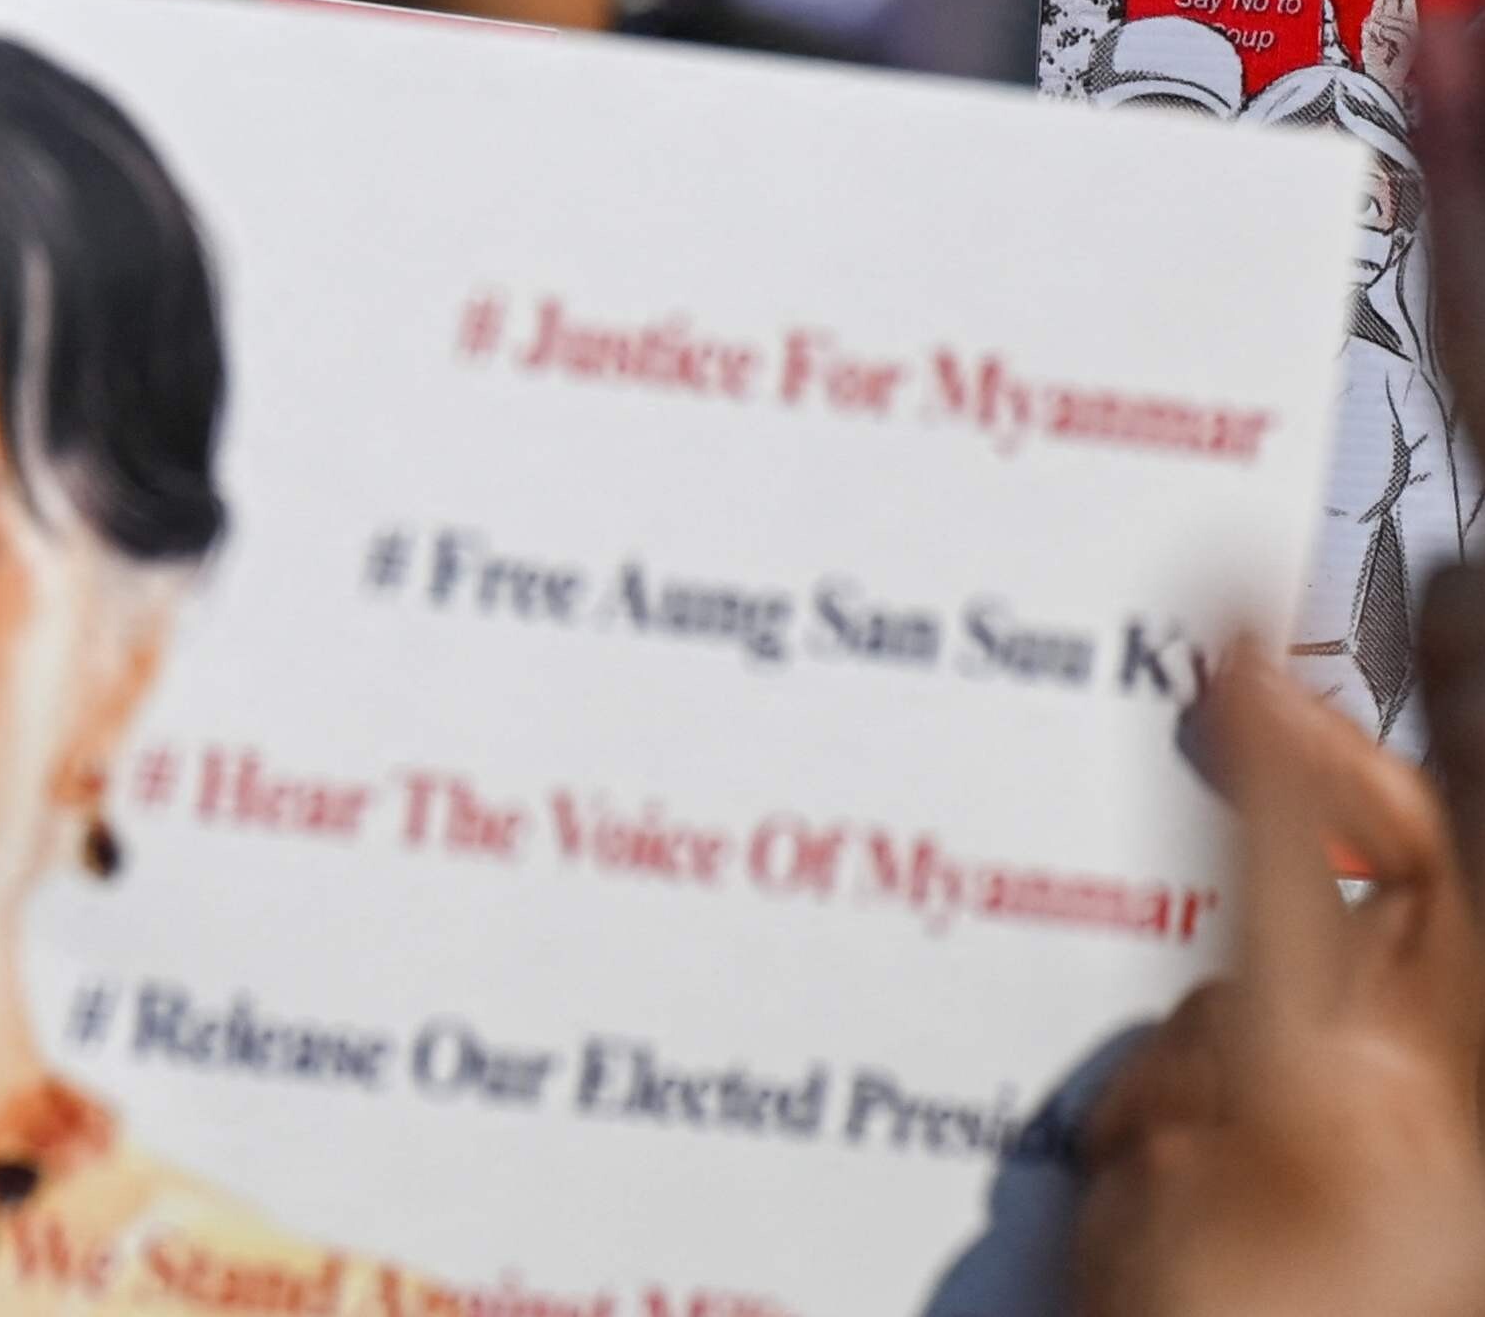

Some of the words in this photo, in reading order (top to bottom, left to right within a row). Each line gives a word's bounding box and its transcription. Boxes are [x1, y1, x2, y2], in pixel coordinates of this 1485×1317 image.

[1213, 22, 1275, 52] oup
[519, 294, 763, 402] Justice
[779, 324, 903, 414] For
[926, 341, 1276, 464] Myanmar
[426, 526, 589, 624] Free
[601, 554, 796, 666] Aung
[811, 574, 943, 668] San
[961, 594, 1098, 690] Suu
[194, 746, 371, 842] Hear
[393, 766, 527, 856] The
[549, 788, 737, 888] Voice
[745, 812, 847, 898] Of
[863, 826, 1221, 948] Myanmar
[129, 976, 396, 1096] Release
[409, 1008, 557, 1111] Our
[571, 1030, 829, 1146] Elected
[11, 1214, 119, 1294] We
[139, 1228, 349, 1317] Stand
